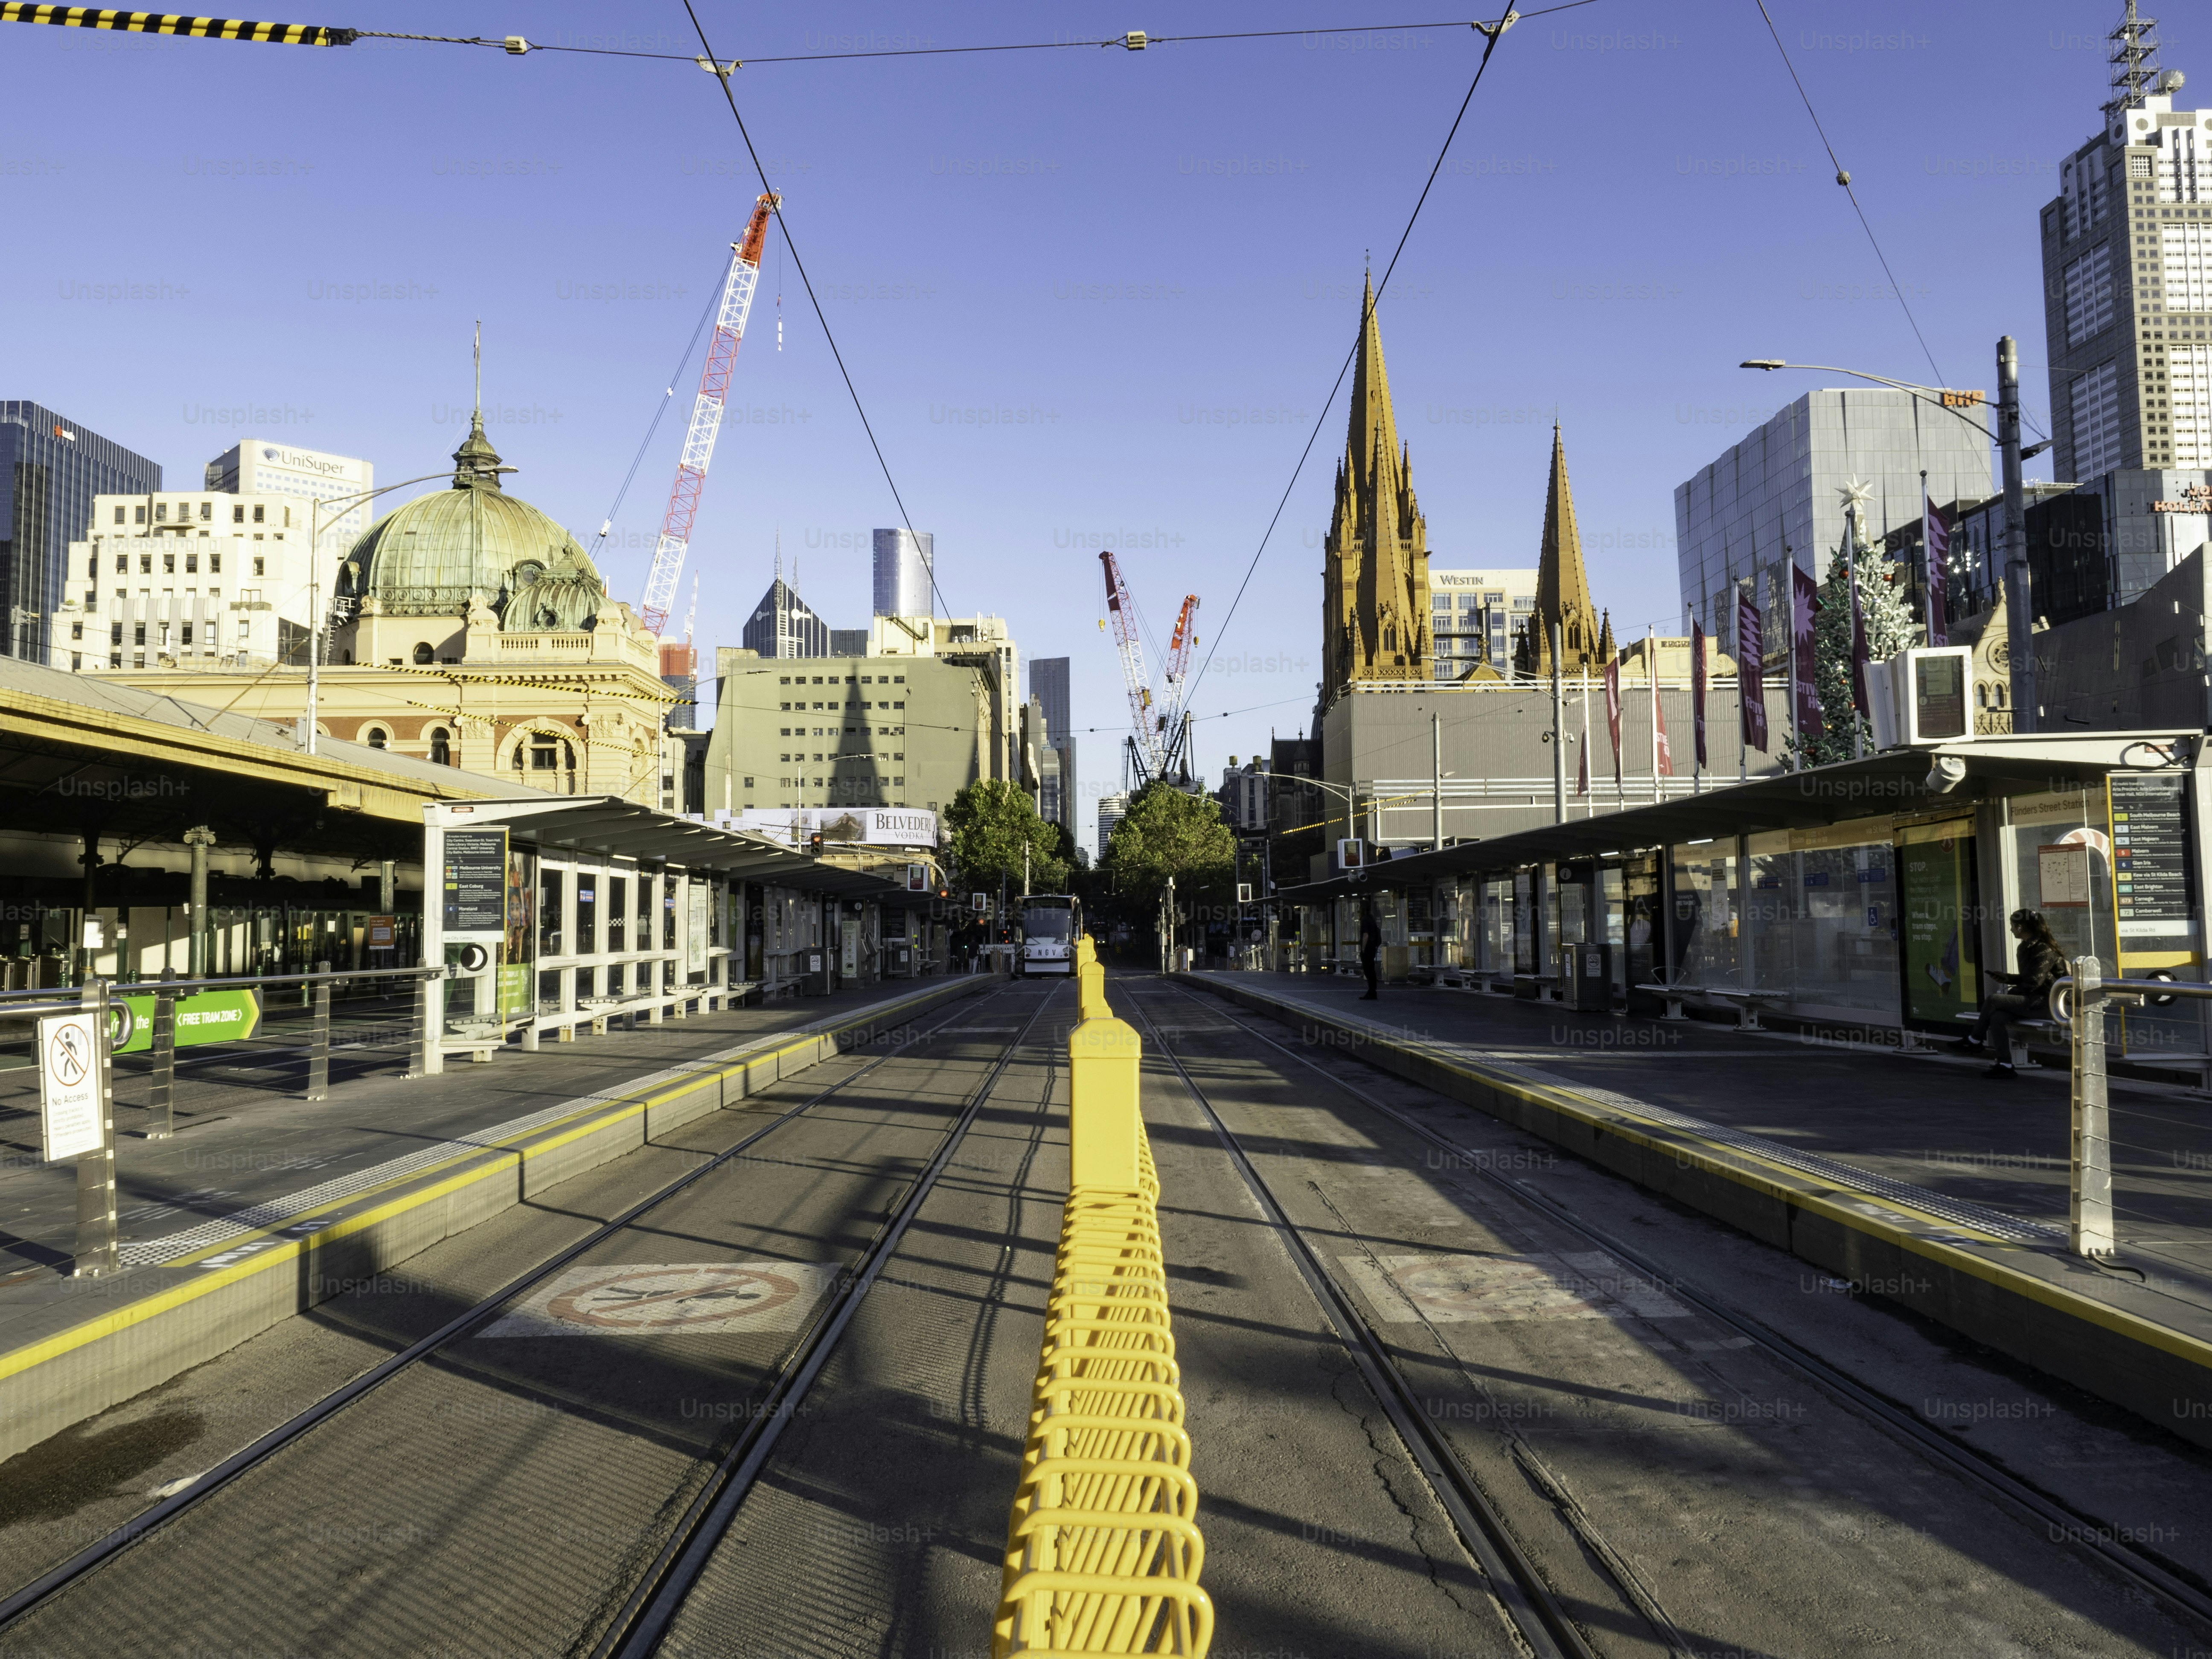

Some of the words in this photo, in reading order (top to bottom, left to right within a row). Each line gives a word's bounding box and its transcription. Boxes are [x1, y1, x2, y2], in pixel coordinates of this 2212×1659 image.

[1944, 391, 1984, 405] BHP
[282, 451, 344, 474] UniSuper
[2189, 485, 2212, 496] JO
[2154, 500, 2212, 512] HOLLA
[2010, 806, 2037, 816] Flinders
[2039, 803, 2061, 813] Street
[2063, 798, 2090, 810] Station
[875, 813, 931, 833] BELVEDERE
[895, 831, 924, 840] VODKA
[1909, 862, 1928, 872] STOP.
[136, 1015, 149, 1030] the
[201, 1011, 221, 1024] TRAM
[52, 1097, 62, 1106] No
[64, 1093, 89, 1104] Access
